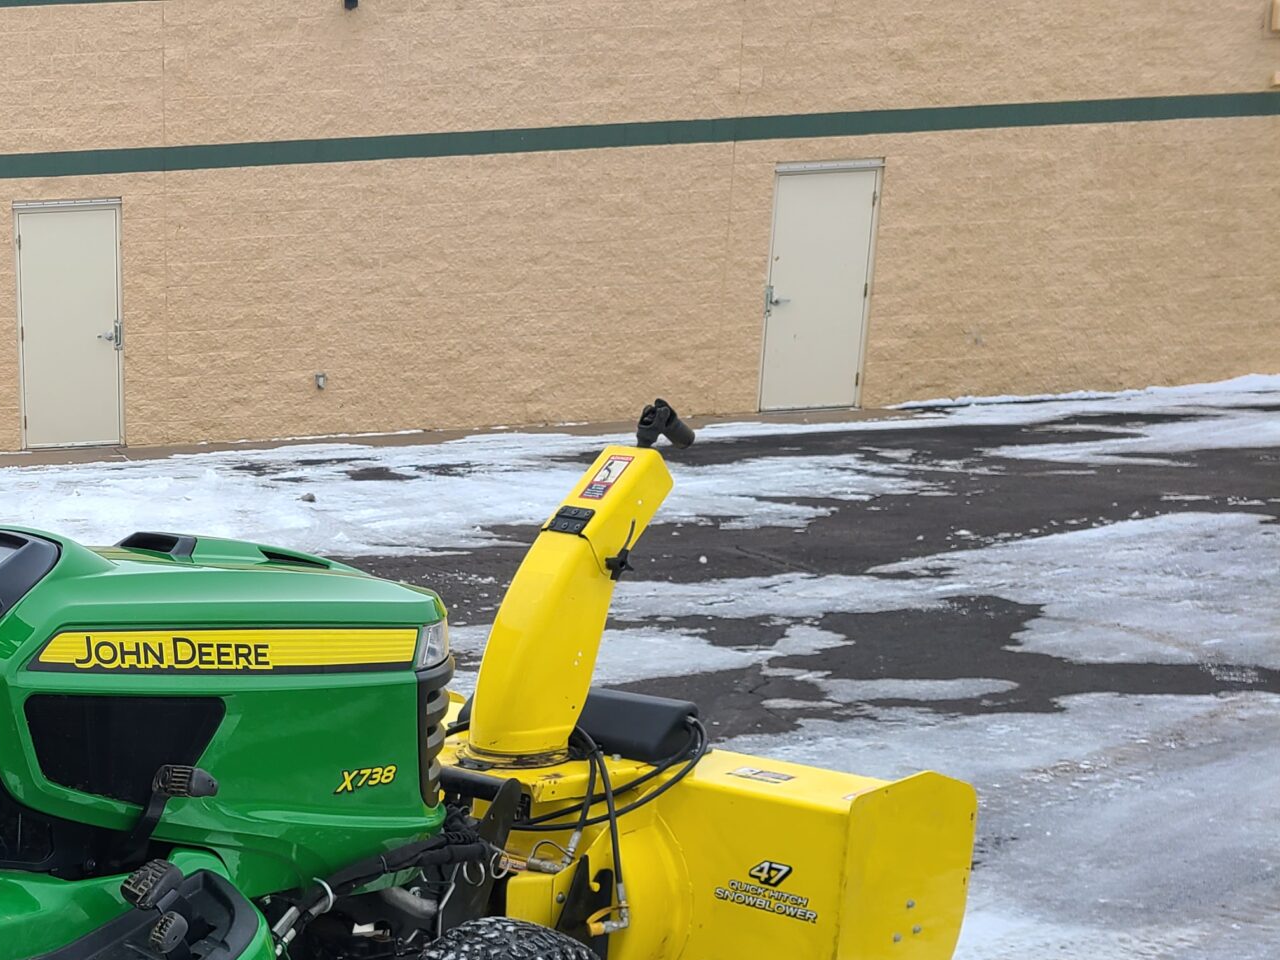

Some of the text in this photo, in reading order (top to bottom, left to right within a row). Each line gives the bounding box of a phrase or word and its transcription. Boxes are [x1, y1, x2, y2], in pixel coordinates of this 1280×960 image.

[75, 636, 271, 667] JOHN DEERE
[334, 764, 397, 794] X738
[749, 860, 793, 887] 47
[714, 886, 818, 923] SNOWBLOWER
[728, 879, 809, 907] QUICK HITCH
